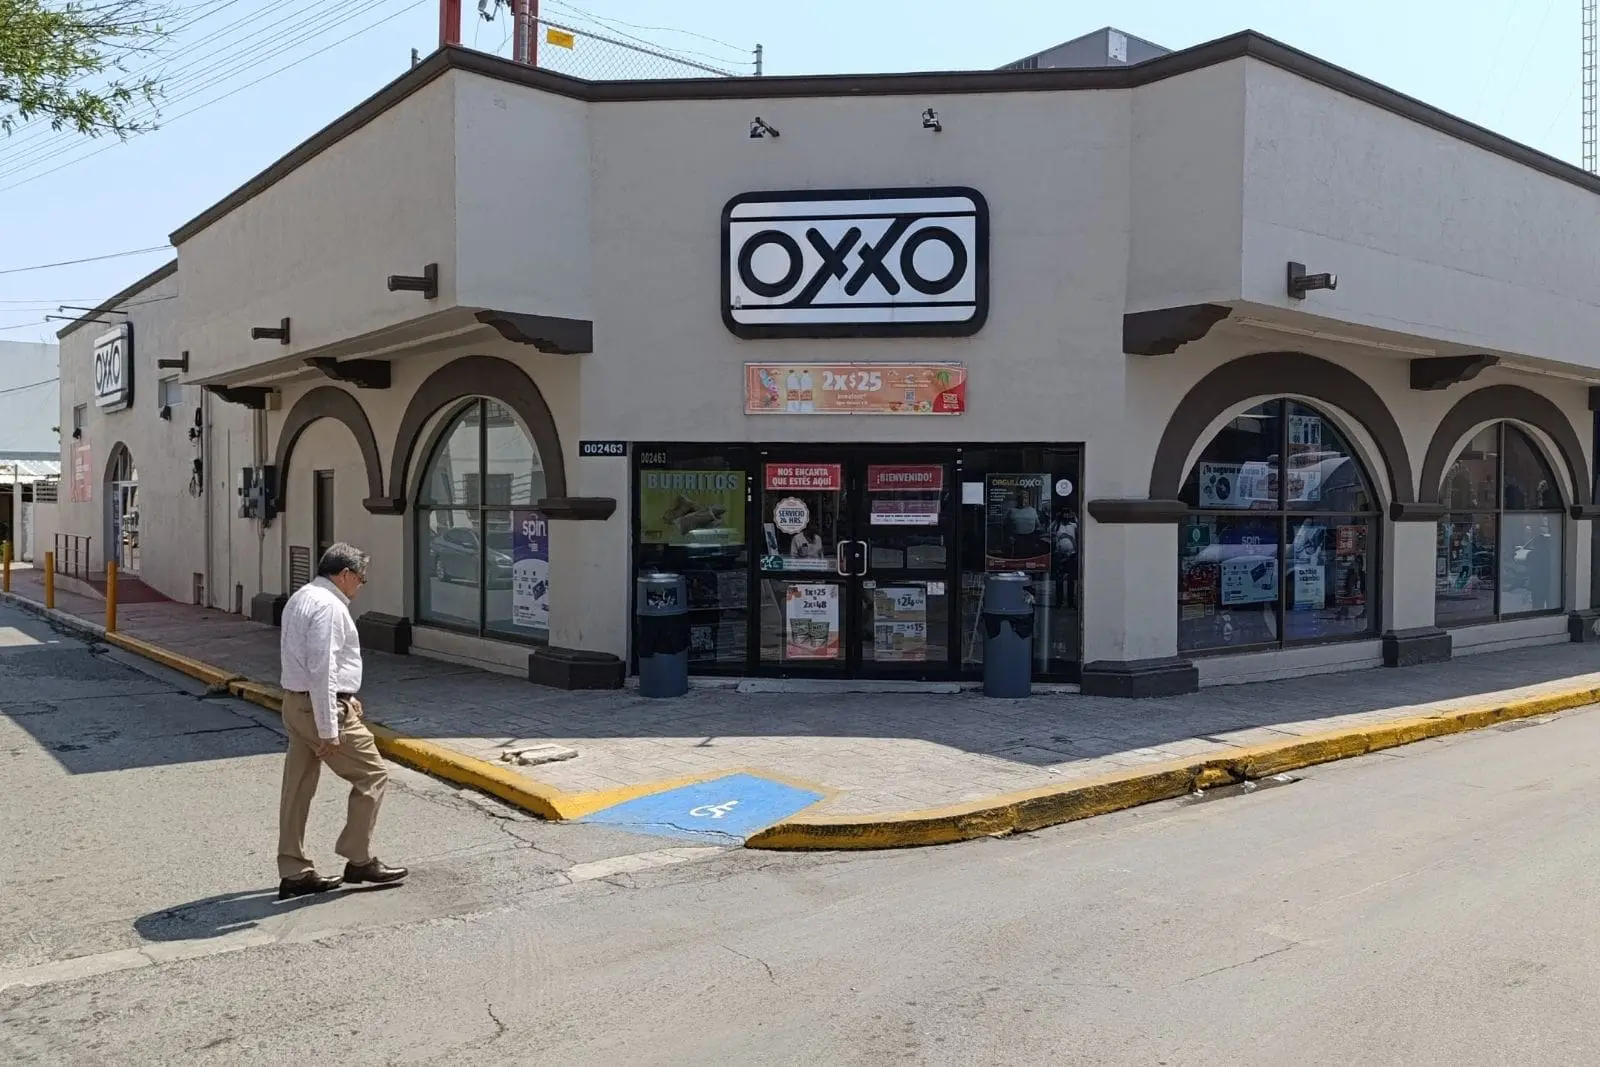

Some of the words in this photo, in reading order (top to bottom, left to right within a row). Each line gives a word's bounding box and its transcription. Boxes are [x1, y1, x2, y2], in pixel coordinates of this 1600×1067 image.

[738, 221, 968, 303] OXXO
[94, 344, 121, 398] OXXO
[822, 370, 882, 392] 2x$25
[584, 444, 623, 454] 002463
[640, 452, 667, 464] 002463
[777, 468, 793, 476] NOS
[795, 468, 829, 476] ENCANTA
[877, 472, 933, 485] ¡BIENVENIDO!
[647, 472, 738, 489] BURRITOS
[772, 477, 787, 486] QUE
[812, 475, 833, 486] AQUÍ
[522, 519, 547, 541] spin
[1241, 535, 1260, 546] spin
